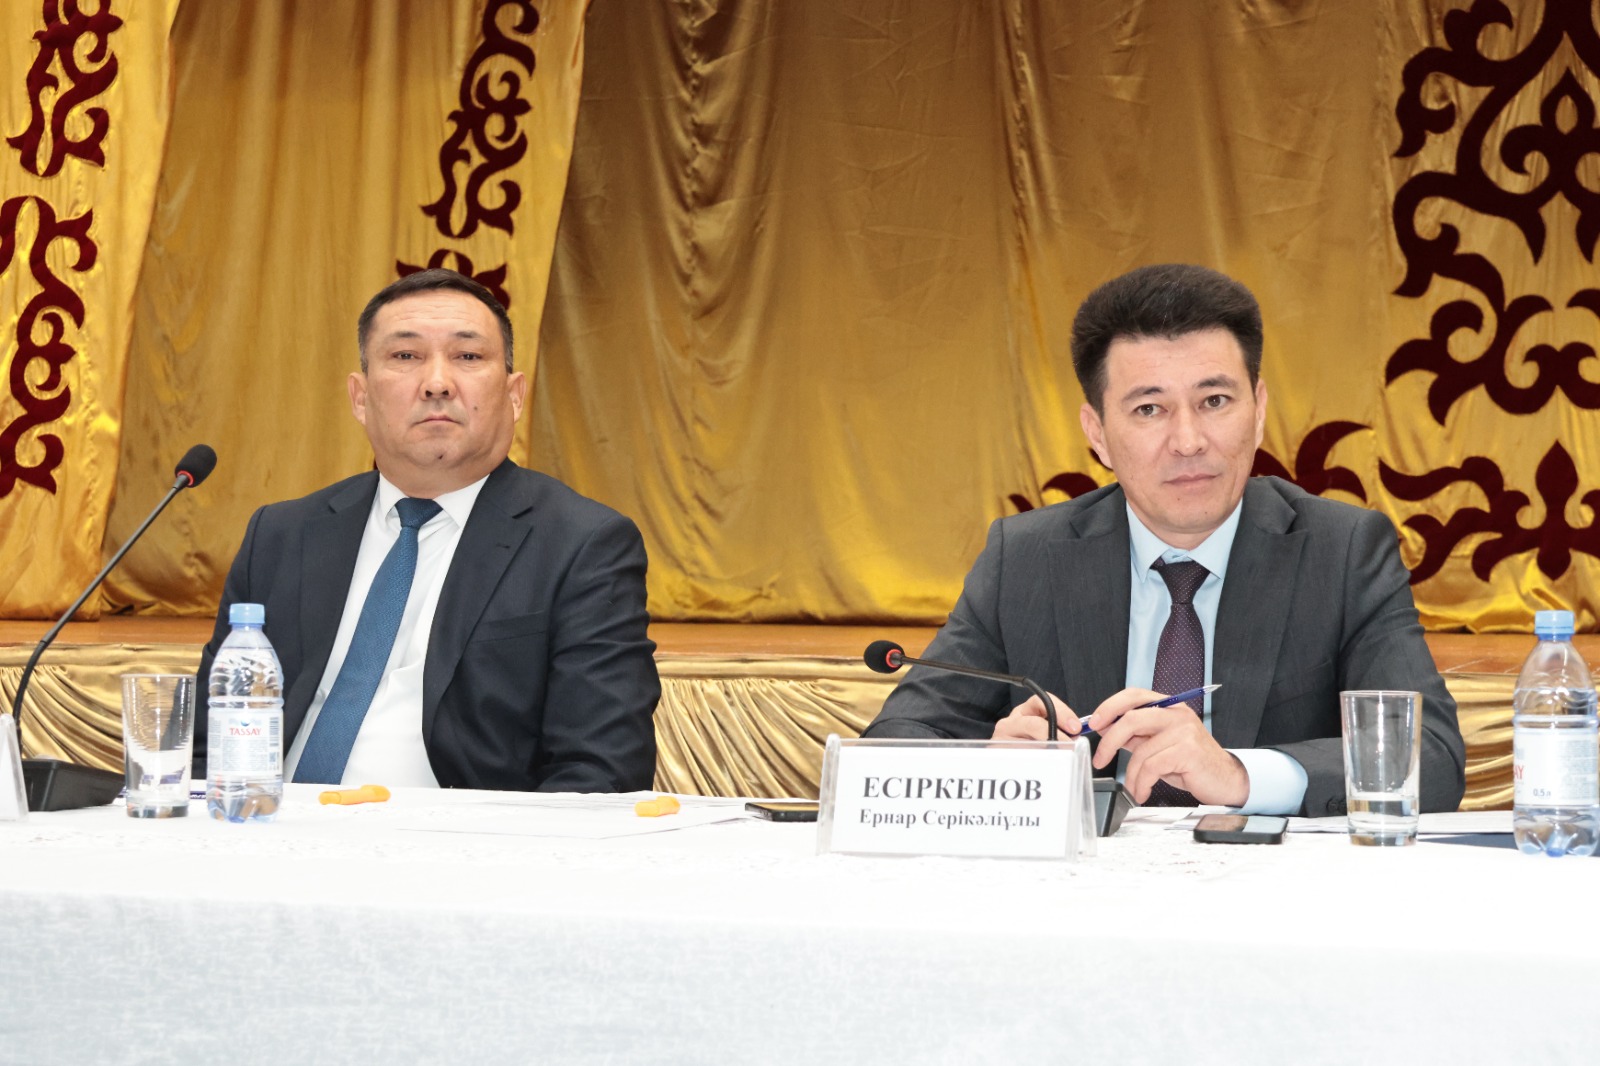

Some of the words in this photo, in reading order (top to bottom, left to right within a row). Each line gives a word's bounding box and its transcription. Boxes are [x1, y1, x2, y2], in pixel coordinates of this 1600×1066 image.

[229, 727, 262, 736] TASSAY
[863, 776, 1042, 801] ЕСІРКЕПОВ
[860, 808, 917, 829] Ернар
